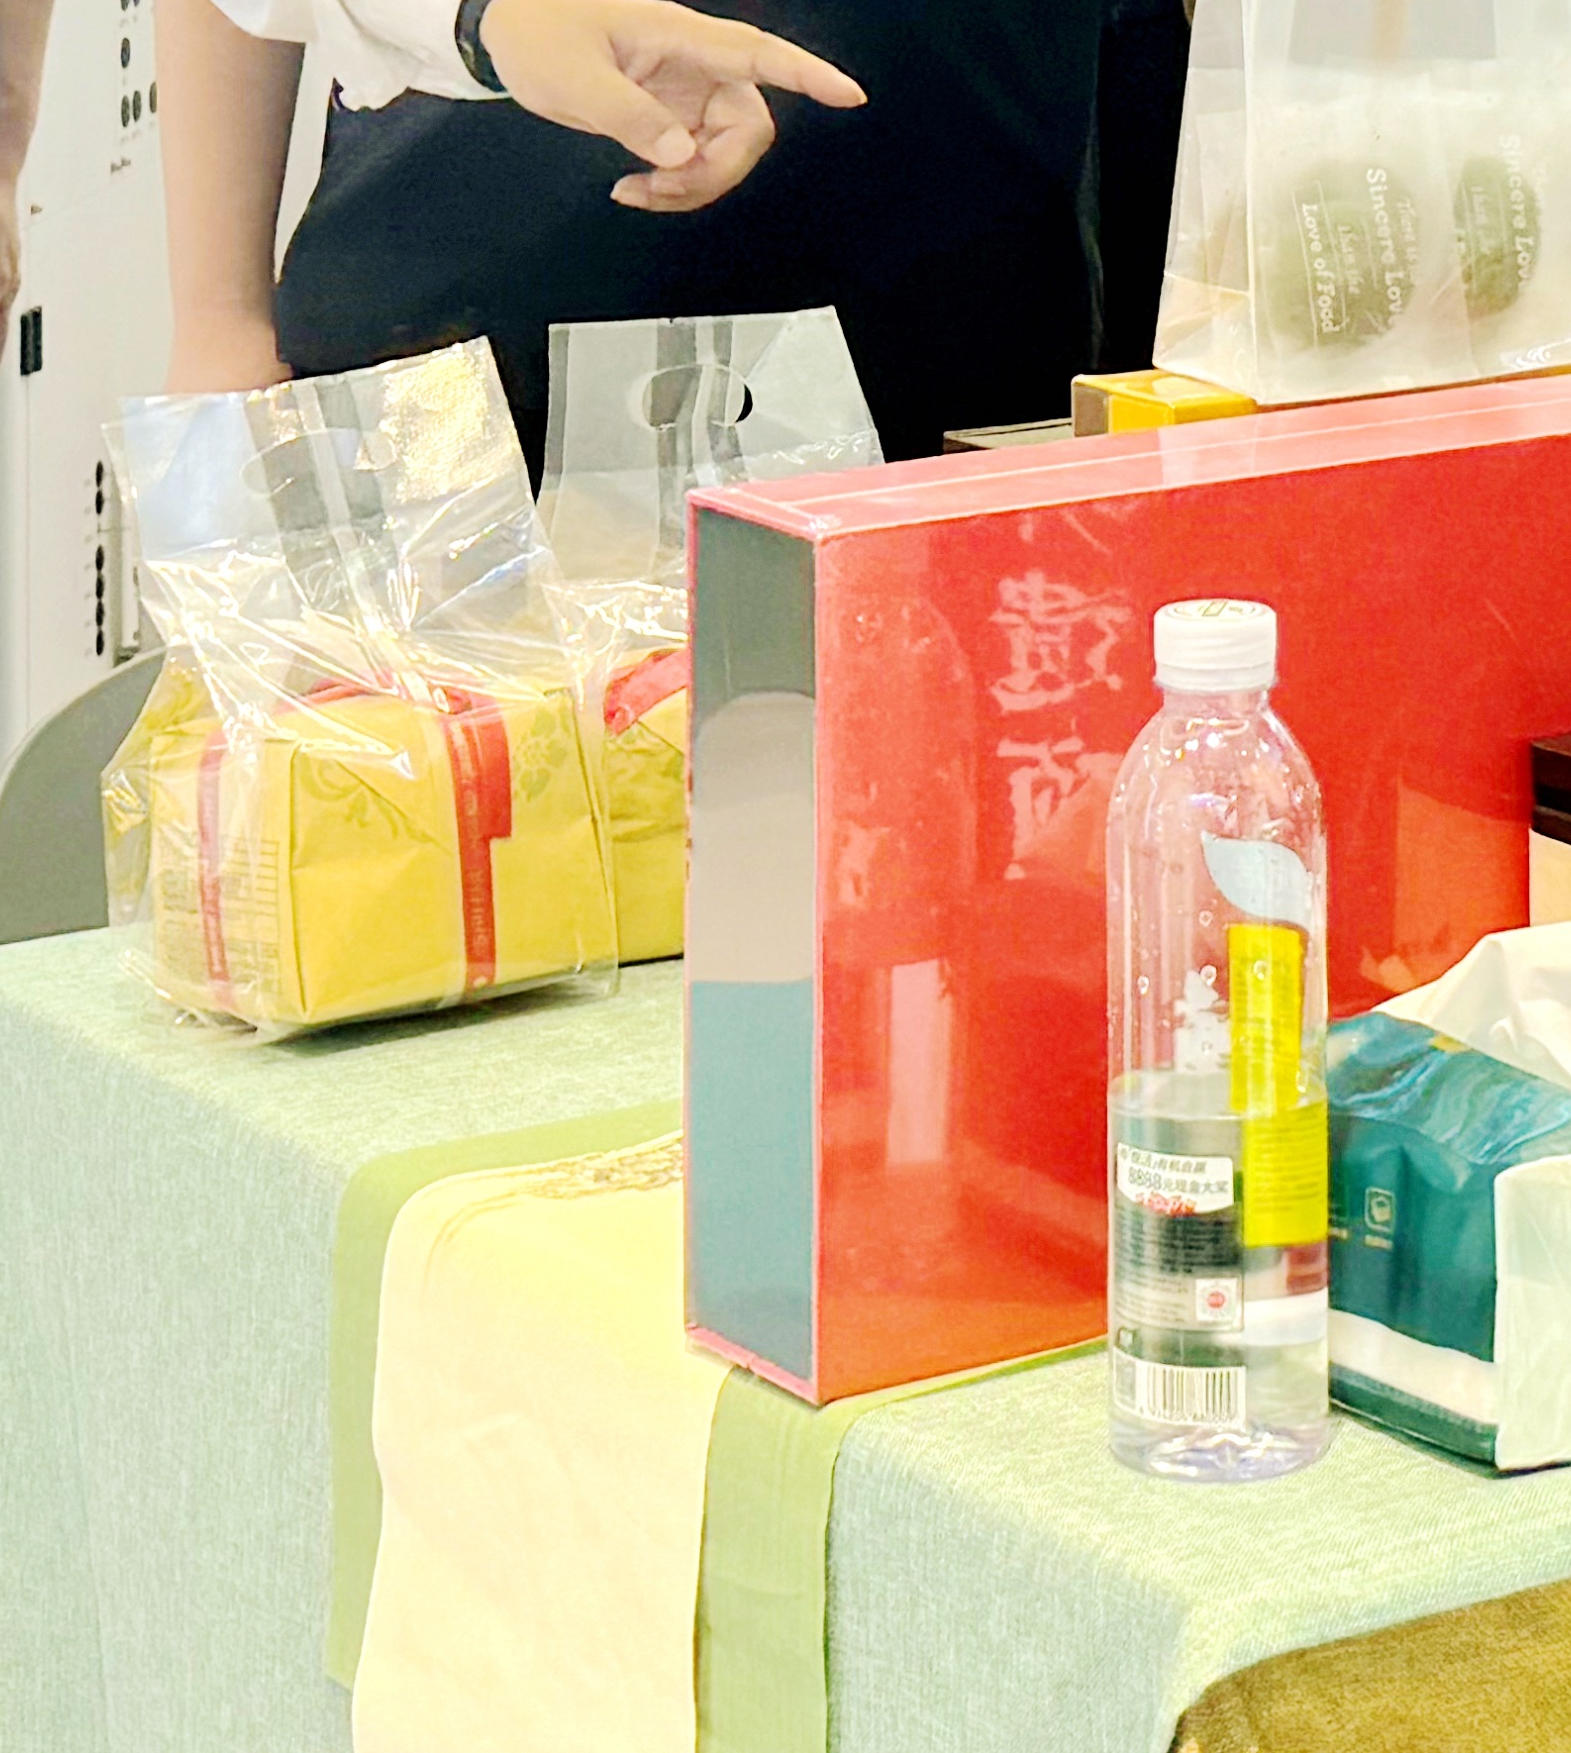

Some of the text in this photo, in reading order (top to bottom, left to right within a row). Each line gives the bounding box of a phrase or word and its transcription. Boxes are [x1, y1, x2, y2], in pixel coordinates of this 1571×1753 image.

[1302, 203, 1341, 333] Love of Food
[1366, 168, 1397, 264] Sincere
